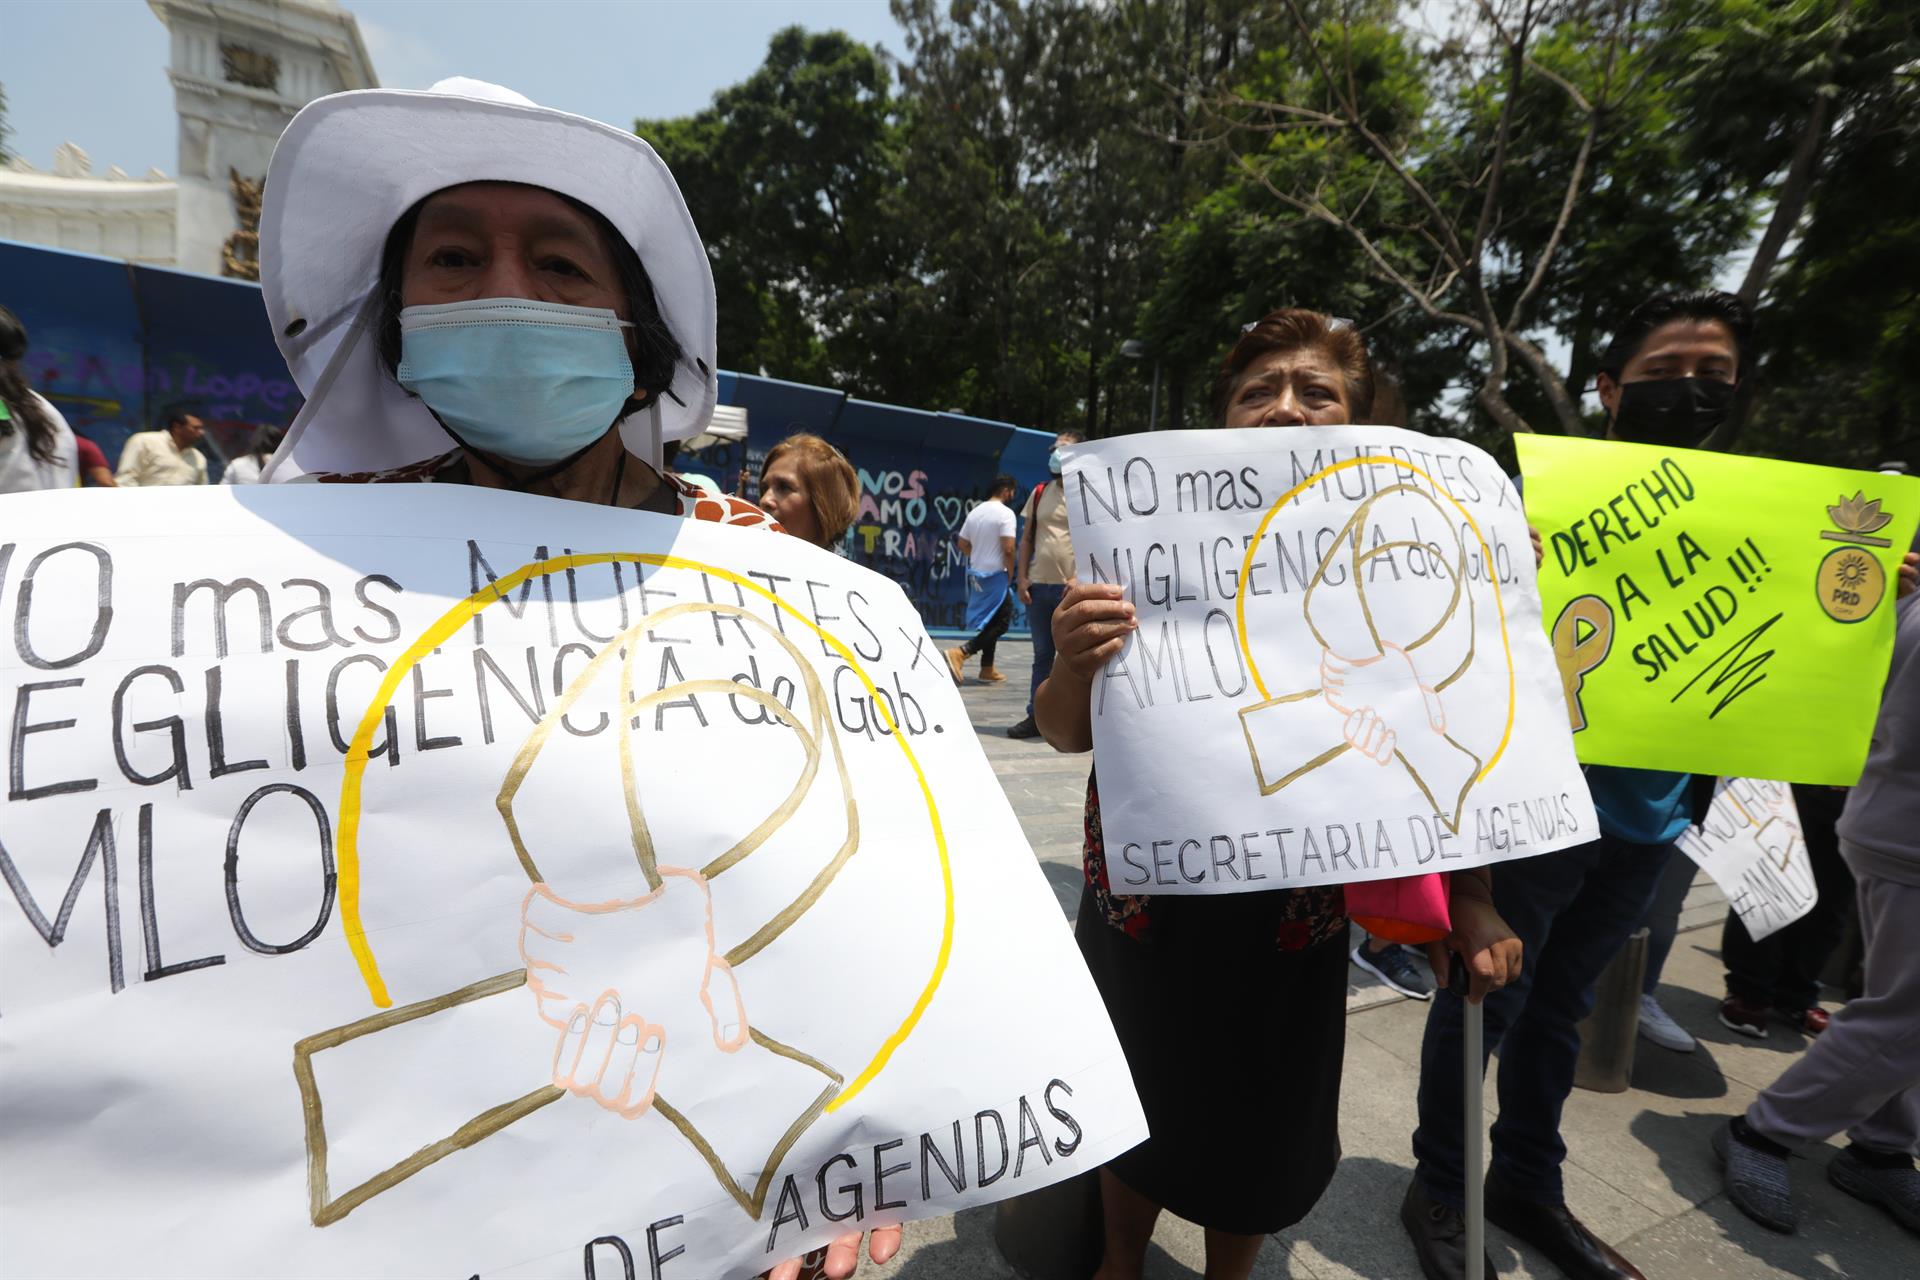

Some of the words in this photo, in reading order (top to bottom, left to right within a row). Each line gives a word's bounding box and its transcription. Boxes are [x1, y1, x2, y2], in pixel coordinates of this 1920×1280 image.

[856, 494, 927, 528] AMO
[857, 468, 929, 499] NOS
[1078, 456, 1159, 525] NO
[1176, 466, 1263, 513] mas
[1290, 445, 1481, 506] MUERTES
[1550, 457, 1696, 577] DERECHO
[1406, 517, 1446, 580] de
[1615, 572, 1651, 622] A
[1655, 530, 1711, 589] LA
[171, 573, 403, 658] mas
[467, 538, 884, 668] MUERTES
[1832, 588, 1861, 606] PRD
[832, 664, 944, 741] Gob.
[1098, 607, 1247, 716] AMLO
[1122, 819, 1399, 886] SECRETARIA
[1407, 812, 1462, 865] DE
[1475, 792, 1579, 854] AGENDAS
[765, 1078, 1082, 1254] AGENDAS
